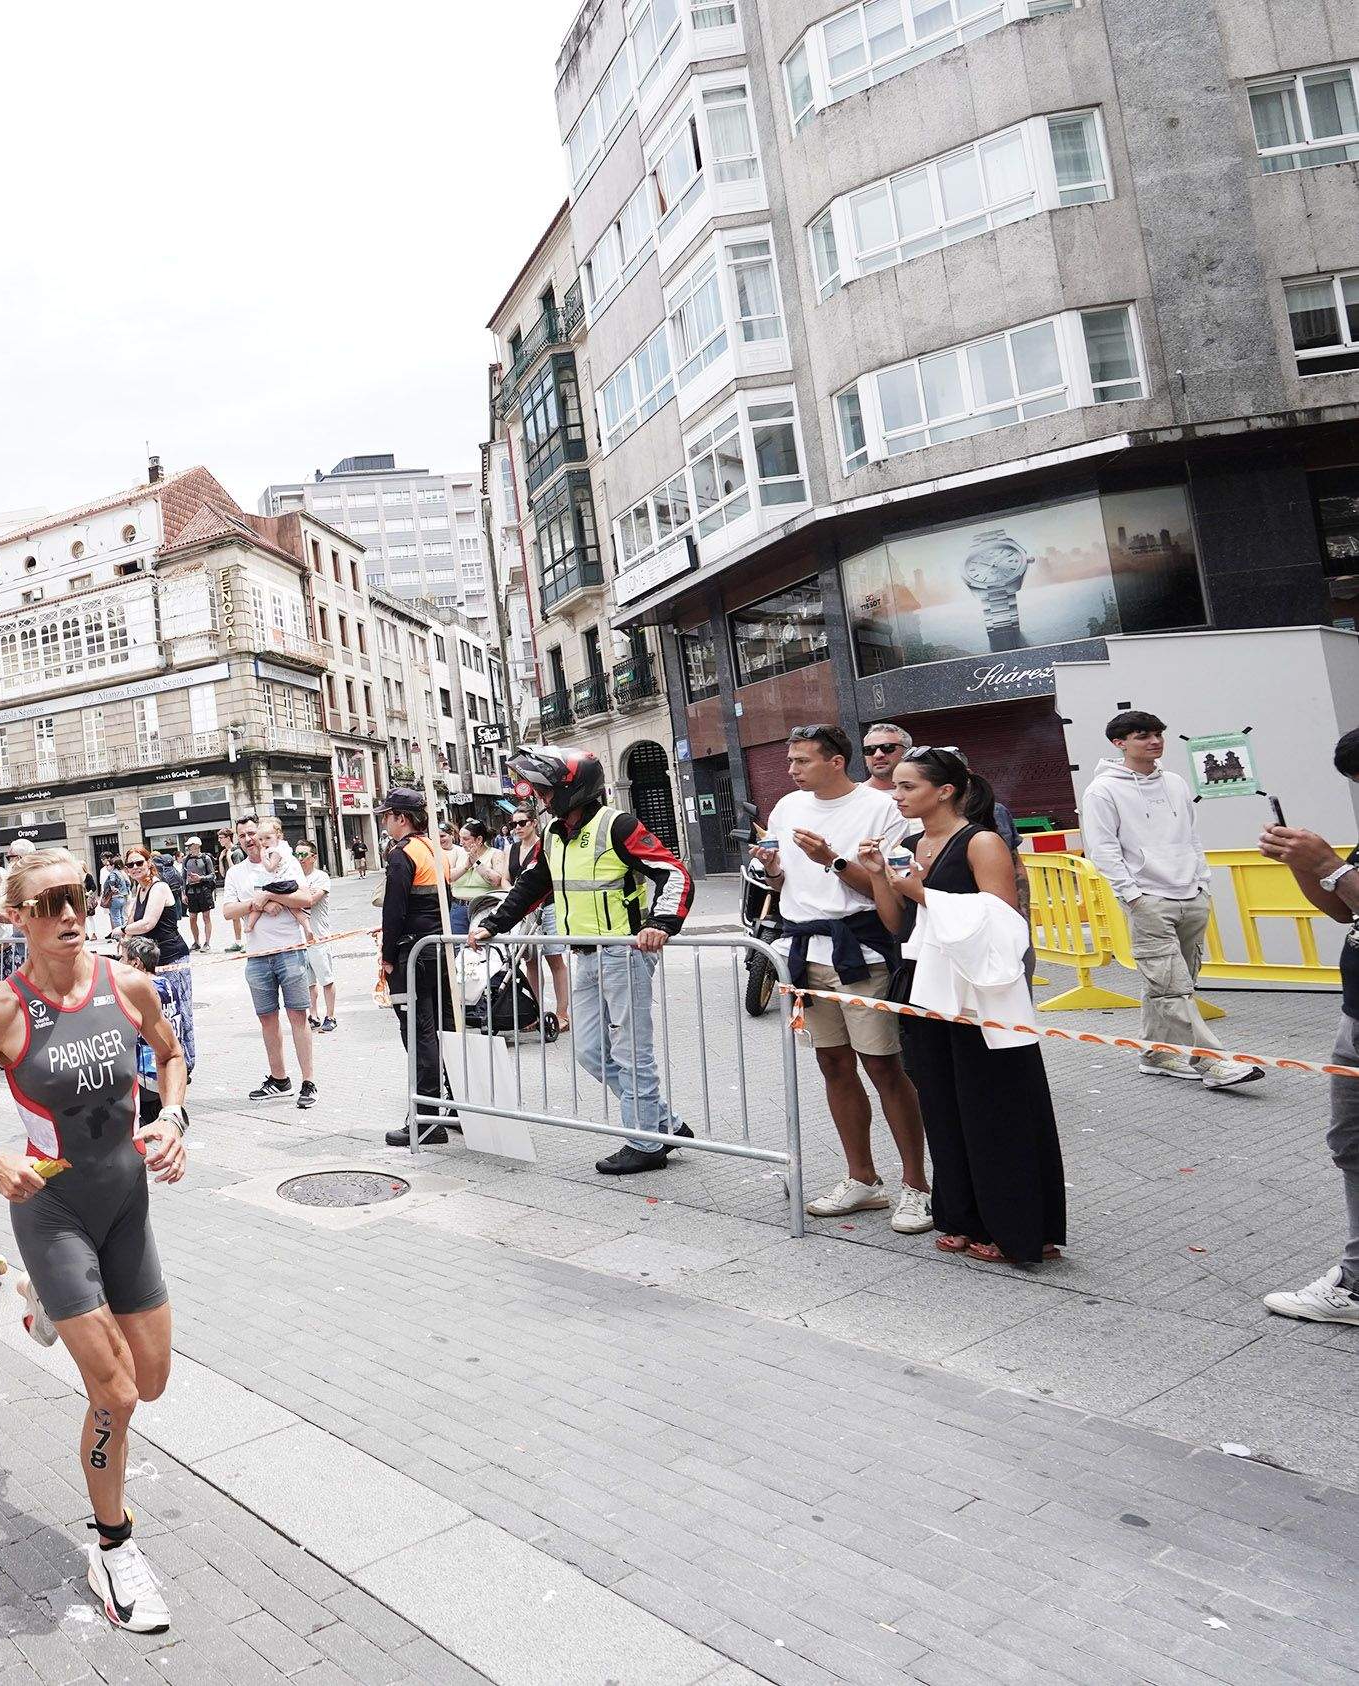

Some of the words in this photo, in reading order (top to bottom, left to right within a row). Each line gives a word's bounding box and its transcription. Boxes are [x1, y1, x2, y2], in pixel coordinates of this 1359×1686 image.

[221, 568, 237, 650] FENOGAL
[97, 689, 124, 701] Alianza
[162, 675, 194, 688] Seguros
[17, 829, 39, 838] Orange
[47, 1029, 127, 1073] PABINGER
[76, 1060, 115, 1095] AUT
[90, 1427, 112, 1470] 78
